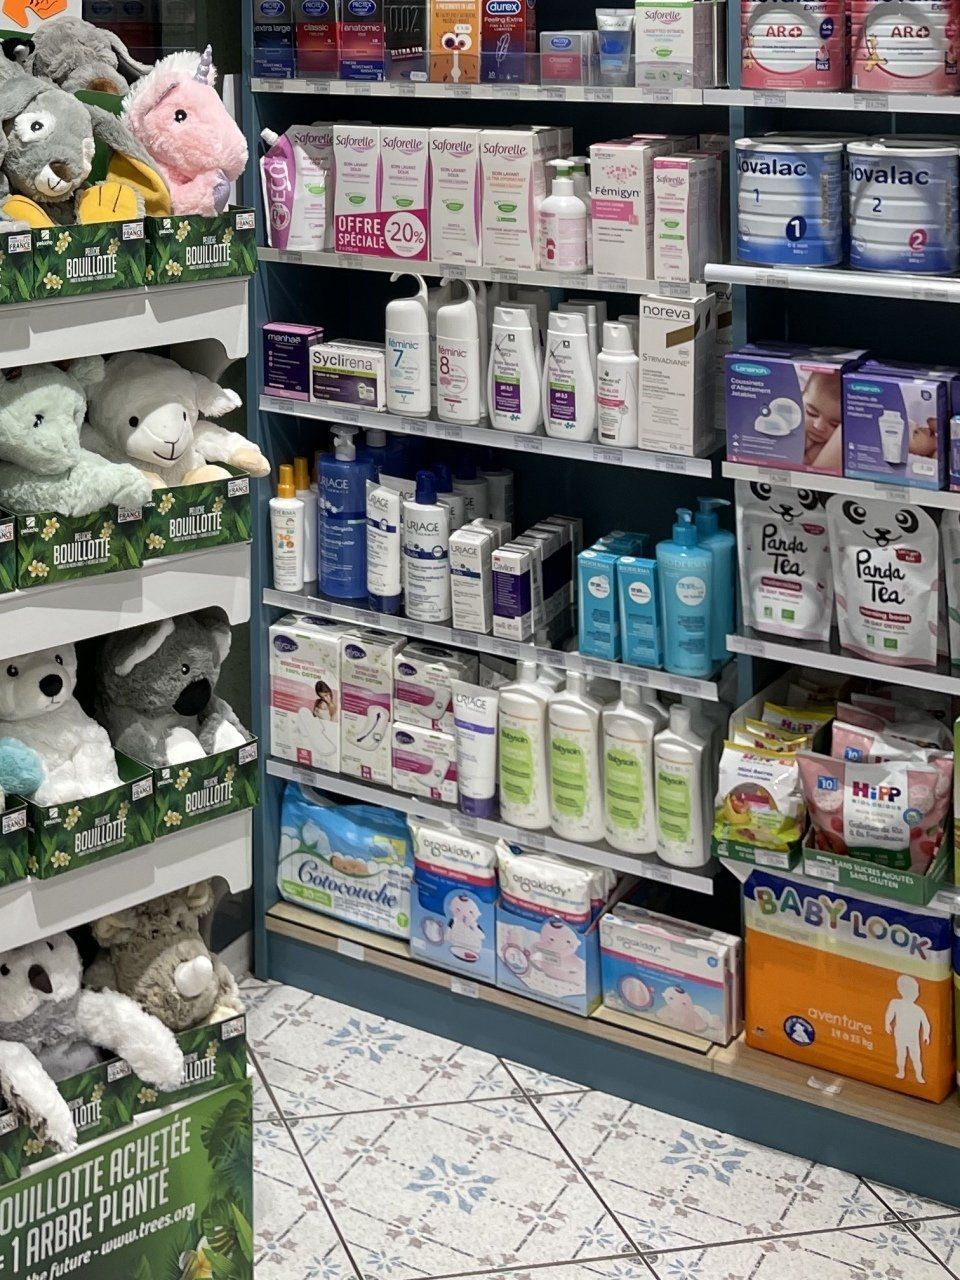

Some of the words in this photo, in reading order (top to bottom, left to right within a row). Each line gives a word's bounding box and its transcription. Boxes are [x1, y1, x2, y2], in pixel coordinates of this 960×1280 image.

[489, 1, 518, 13] durex
[644, 10, 683, 22] Saforelle
[303, 23, 330, 32] classic
[344, 24, 381, 32] anatomic
[335, 134, 376, 148] Saforelle
[383, 136, 423, 150] Saforelle
[432, 138, 474, 152] Saforelle
[483, 142, 527, 157] Saforelle
[656, 174, 686, 186] Saforelle
[595, 185, 640, 199] Fémigyn
[872, 196, 882, 213] 2
[338, 215, 382, 235] OFFRE
[386, 221, 425, 244] -20%
[790, 219, 801, 237] 1
[338, 231, 385, 250] SPÉCIALE
[912, 231, 924, 248] 2
[185, 241, 232, 267] BOUILLOTTE
[65, 253, 118, 279] BOUILLOTTE
[642, 303, 691, 320] noreva
[312, 350, 374, 371] Syclirena
[392, 349, 405, 368] 7
[440, 356, 450, 375] 8
[169, 511, 222, 538] BOUILLOTTE
[406, 521, 440, 535] URIAGE
[761, 523, 808, 554] Panda
[52, 538, 112, 567] BOUILLOTTE
[450, 544, 479, 557] URIAGE
[767, 552, 805, 577] Tea
[856, 549, 906, 580] Panda
[864, 579, 906, 605] Tea
[456, 693, 487, 710] URIAGE
[185, 781, 234, 814] BOUILLOTTE
[74, 818, 127, 853] BOUILLOTTE
[298, 858, 399, 908] Cotocouche
[865, 875, 899, 889] GLUTEN
[753, 885, 848, 931] BABY
[849, 909, 933, 962] LOOK
[807, 1007, 873, 1035] aventure
[109, 1114, 192, 1188] ACHETÉE
[11, 1237, 20, 1275] 1
[25, 1200, 93, 1268] ARBRE
[100, 1201, 196, 1263] www.trees.org
